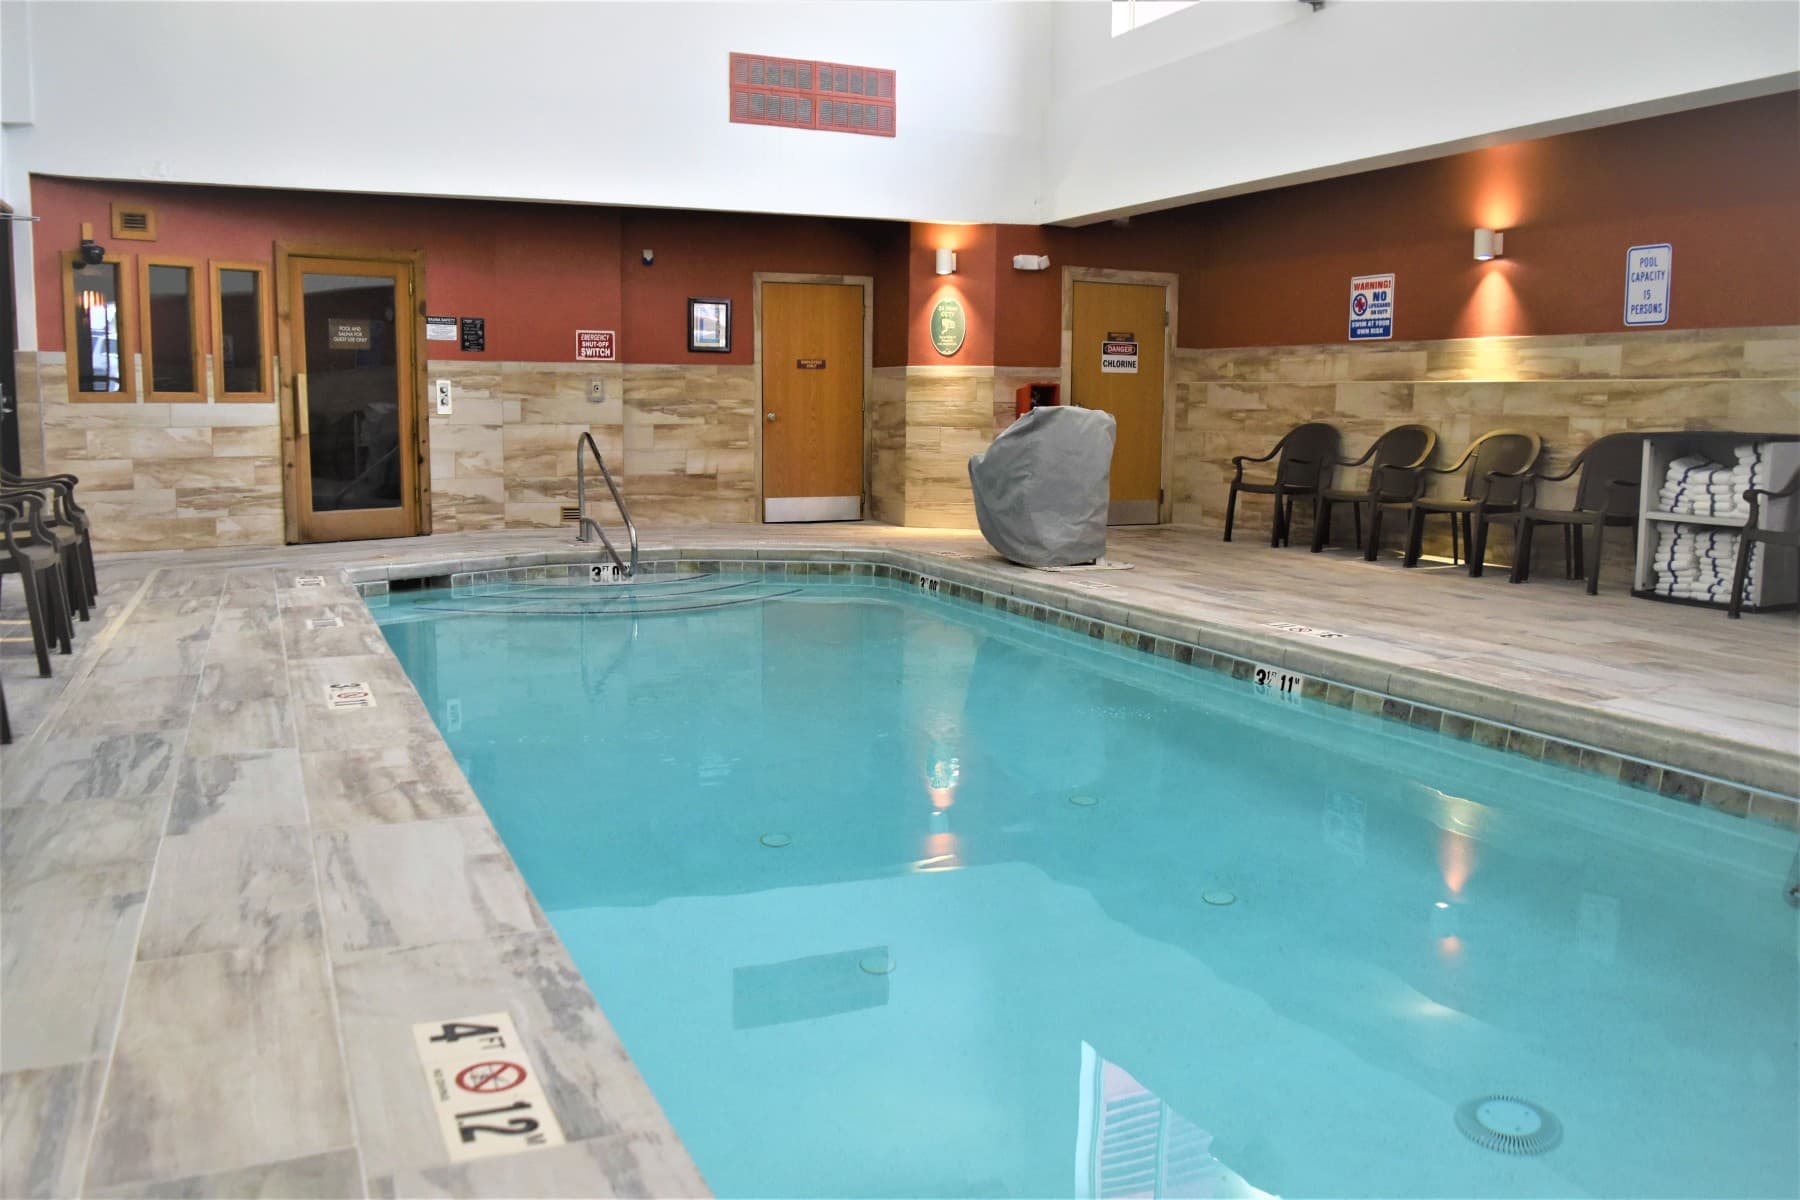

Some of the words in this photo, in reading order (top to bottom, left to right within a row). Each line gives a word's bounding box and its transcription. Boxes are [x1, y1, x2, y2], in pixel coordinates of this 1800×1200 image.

[1640, 256, 1658, 268] POOL
[1631, 270, 1665, 283] CAPACITY
[1354, 280, 1391, 291] WARNING!
[1373, 291, 1387, 302] NO
[1631, 303, 1663, 315] PERSONS
[581, 333, 610, 341] EMERGENCY
[581, 348, 610, 357] SWITCH
[1107, 344, 1133, 353] DANGER
[1103, 359, 1137, 369] CHLORINE
[592, 566, 601, 582] 3
[429, 1023, 499, 1043] 4
